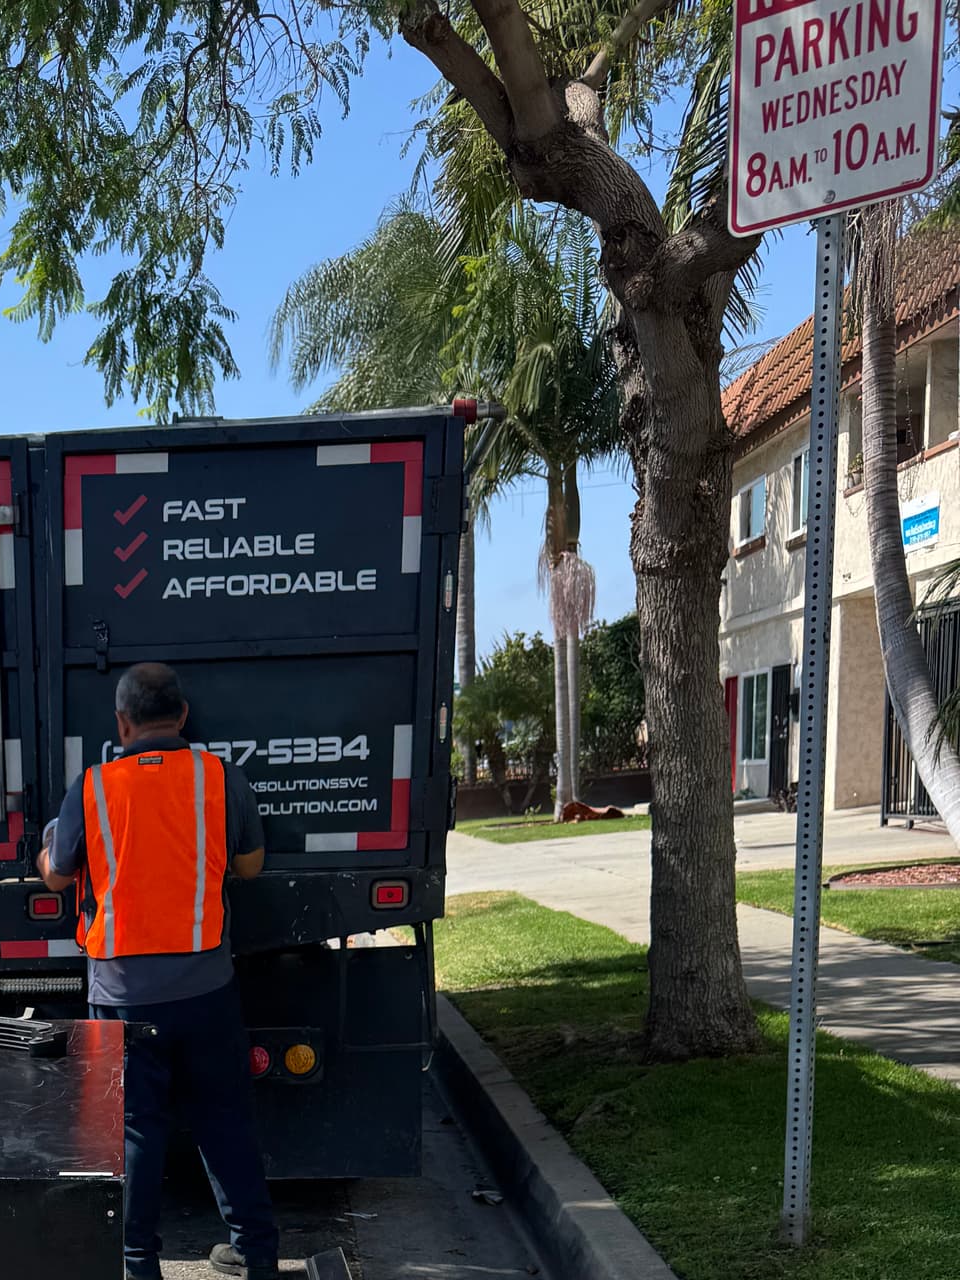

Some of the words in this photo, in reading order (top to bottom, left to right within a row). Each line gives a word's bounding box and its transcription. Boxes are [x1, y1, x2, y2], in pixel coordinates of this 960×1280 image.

[754, 0, 919, 88] PARKING
[761, 58, 907, 134] WEDNESDAY
[814, 147, 828, 164] TO
[163, 497, 246, 522] FAST
[163, 533, 315, 561] RELIABLE
[162, 569, 377, 599] AFFORDABLE
[249, 777, 368, 793] KSOLUTIONSSVC
[257, 799, 378, 816] OLUTION.COM
